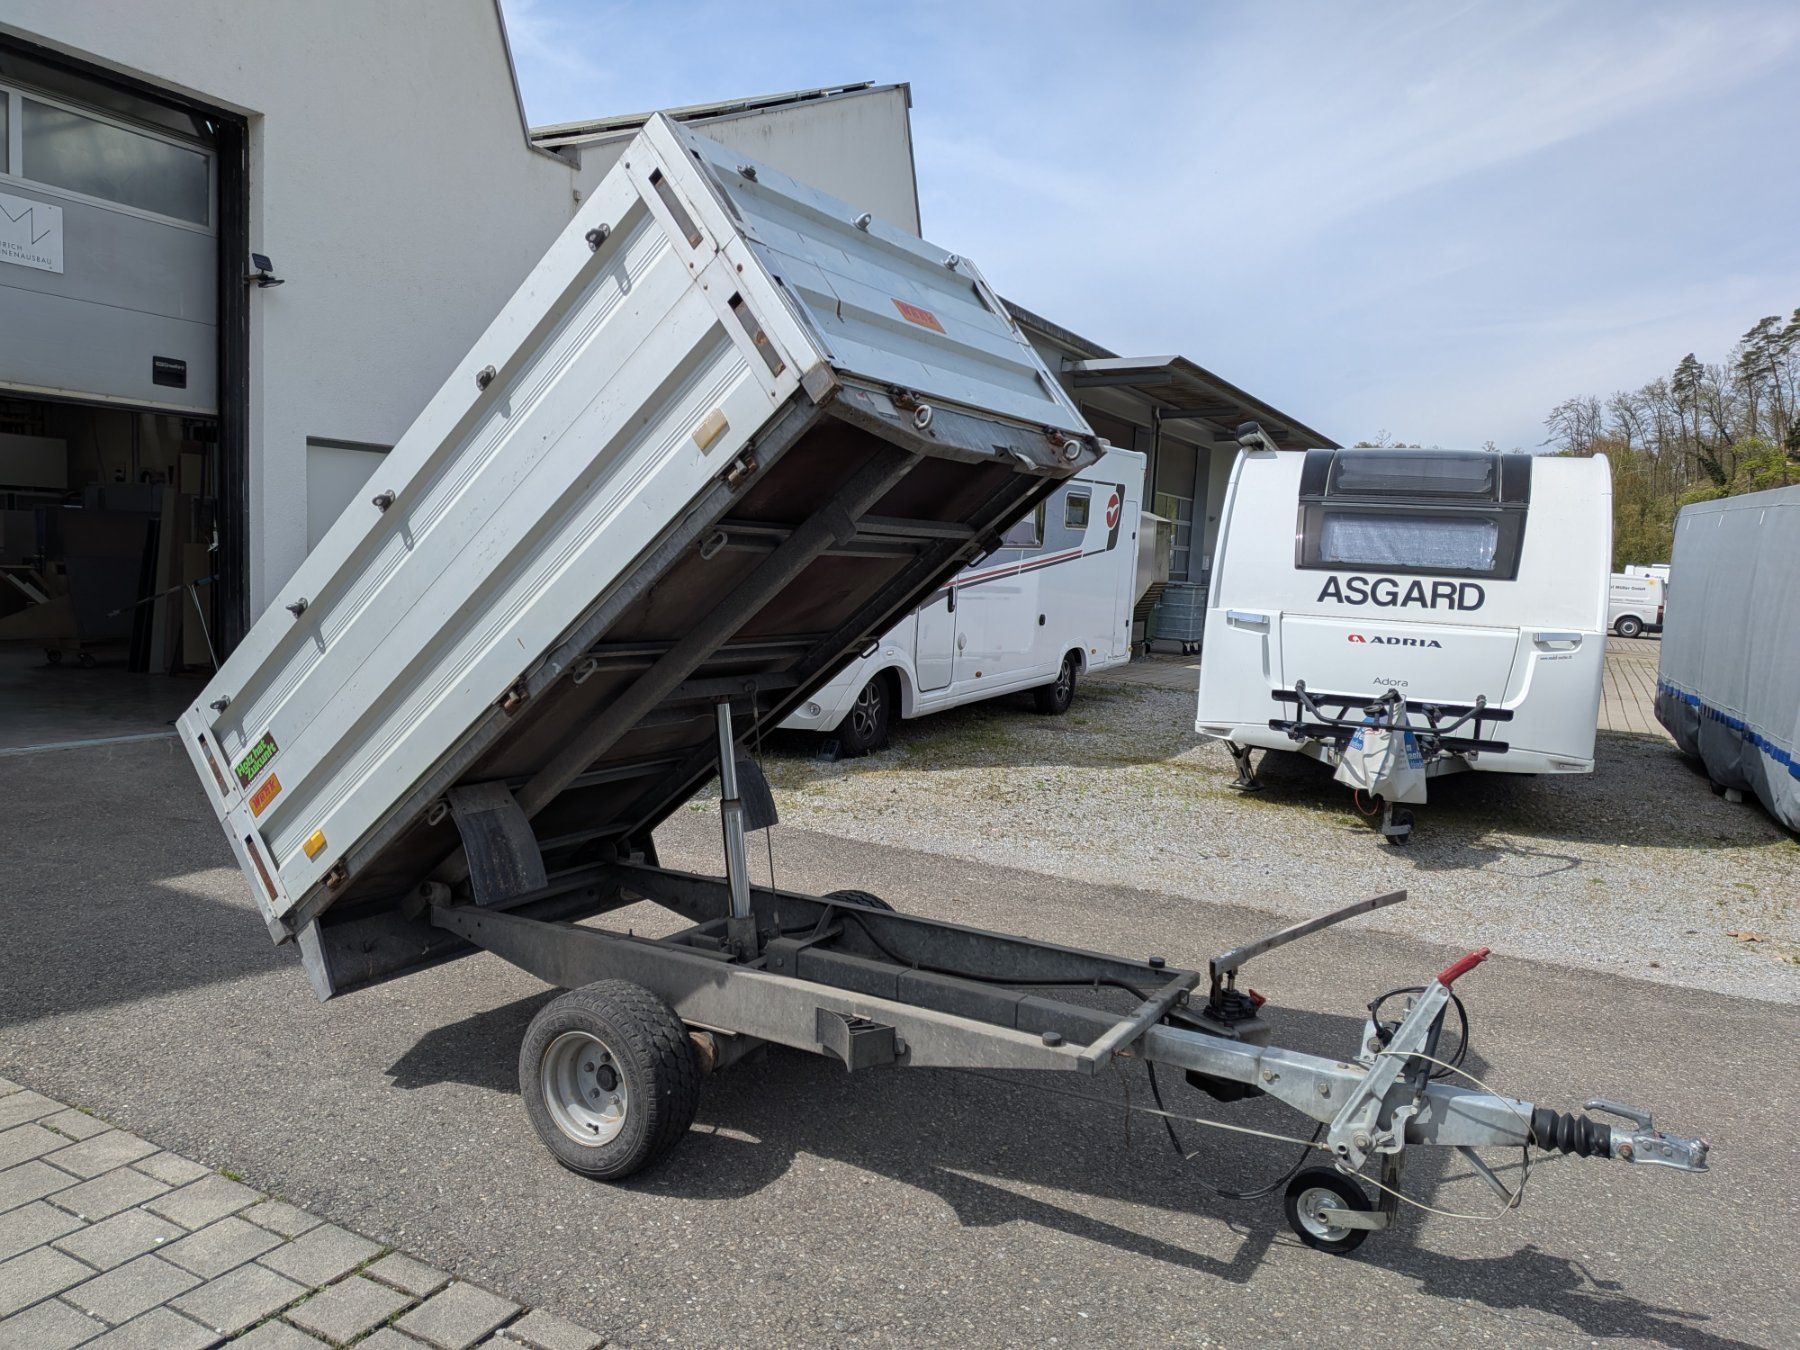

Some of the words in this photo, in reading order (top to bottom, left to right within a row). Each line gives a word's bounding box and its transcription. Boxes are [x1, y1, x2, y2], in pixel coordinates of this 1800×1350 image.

[0, 240, 23, 251] RICH
[0, 249, 52, 265] NENAUSBAU
[1316, 575, 1486, 612] ASGARD
[1370, 635, 1443, 649] ADRIA
[1373, 676, 1409, 688] Adora
